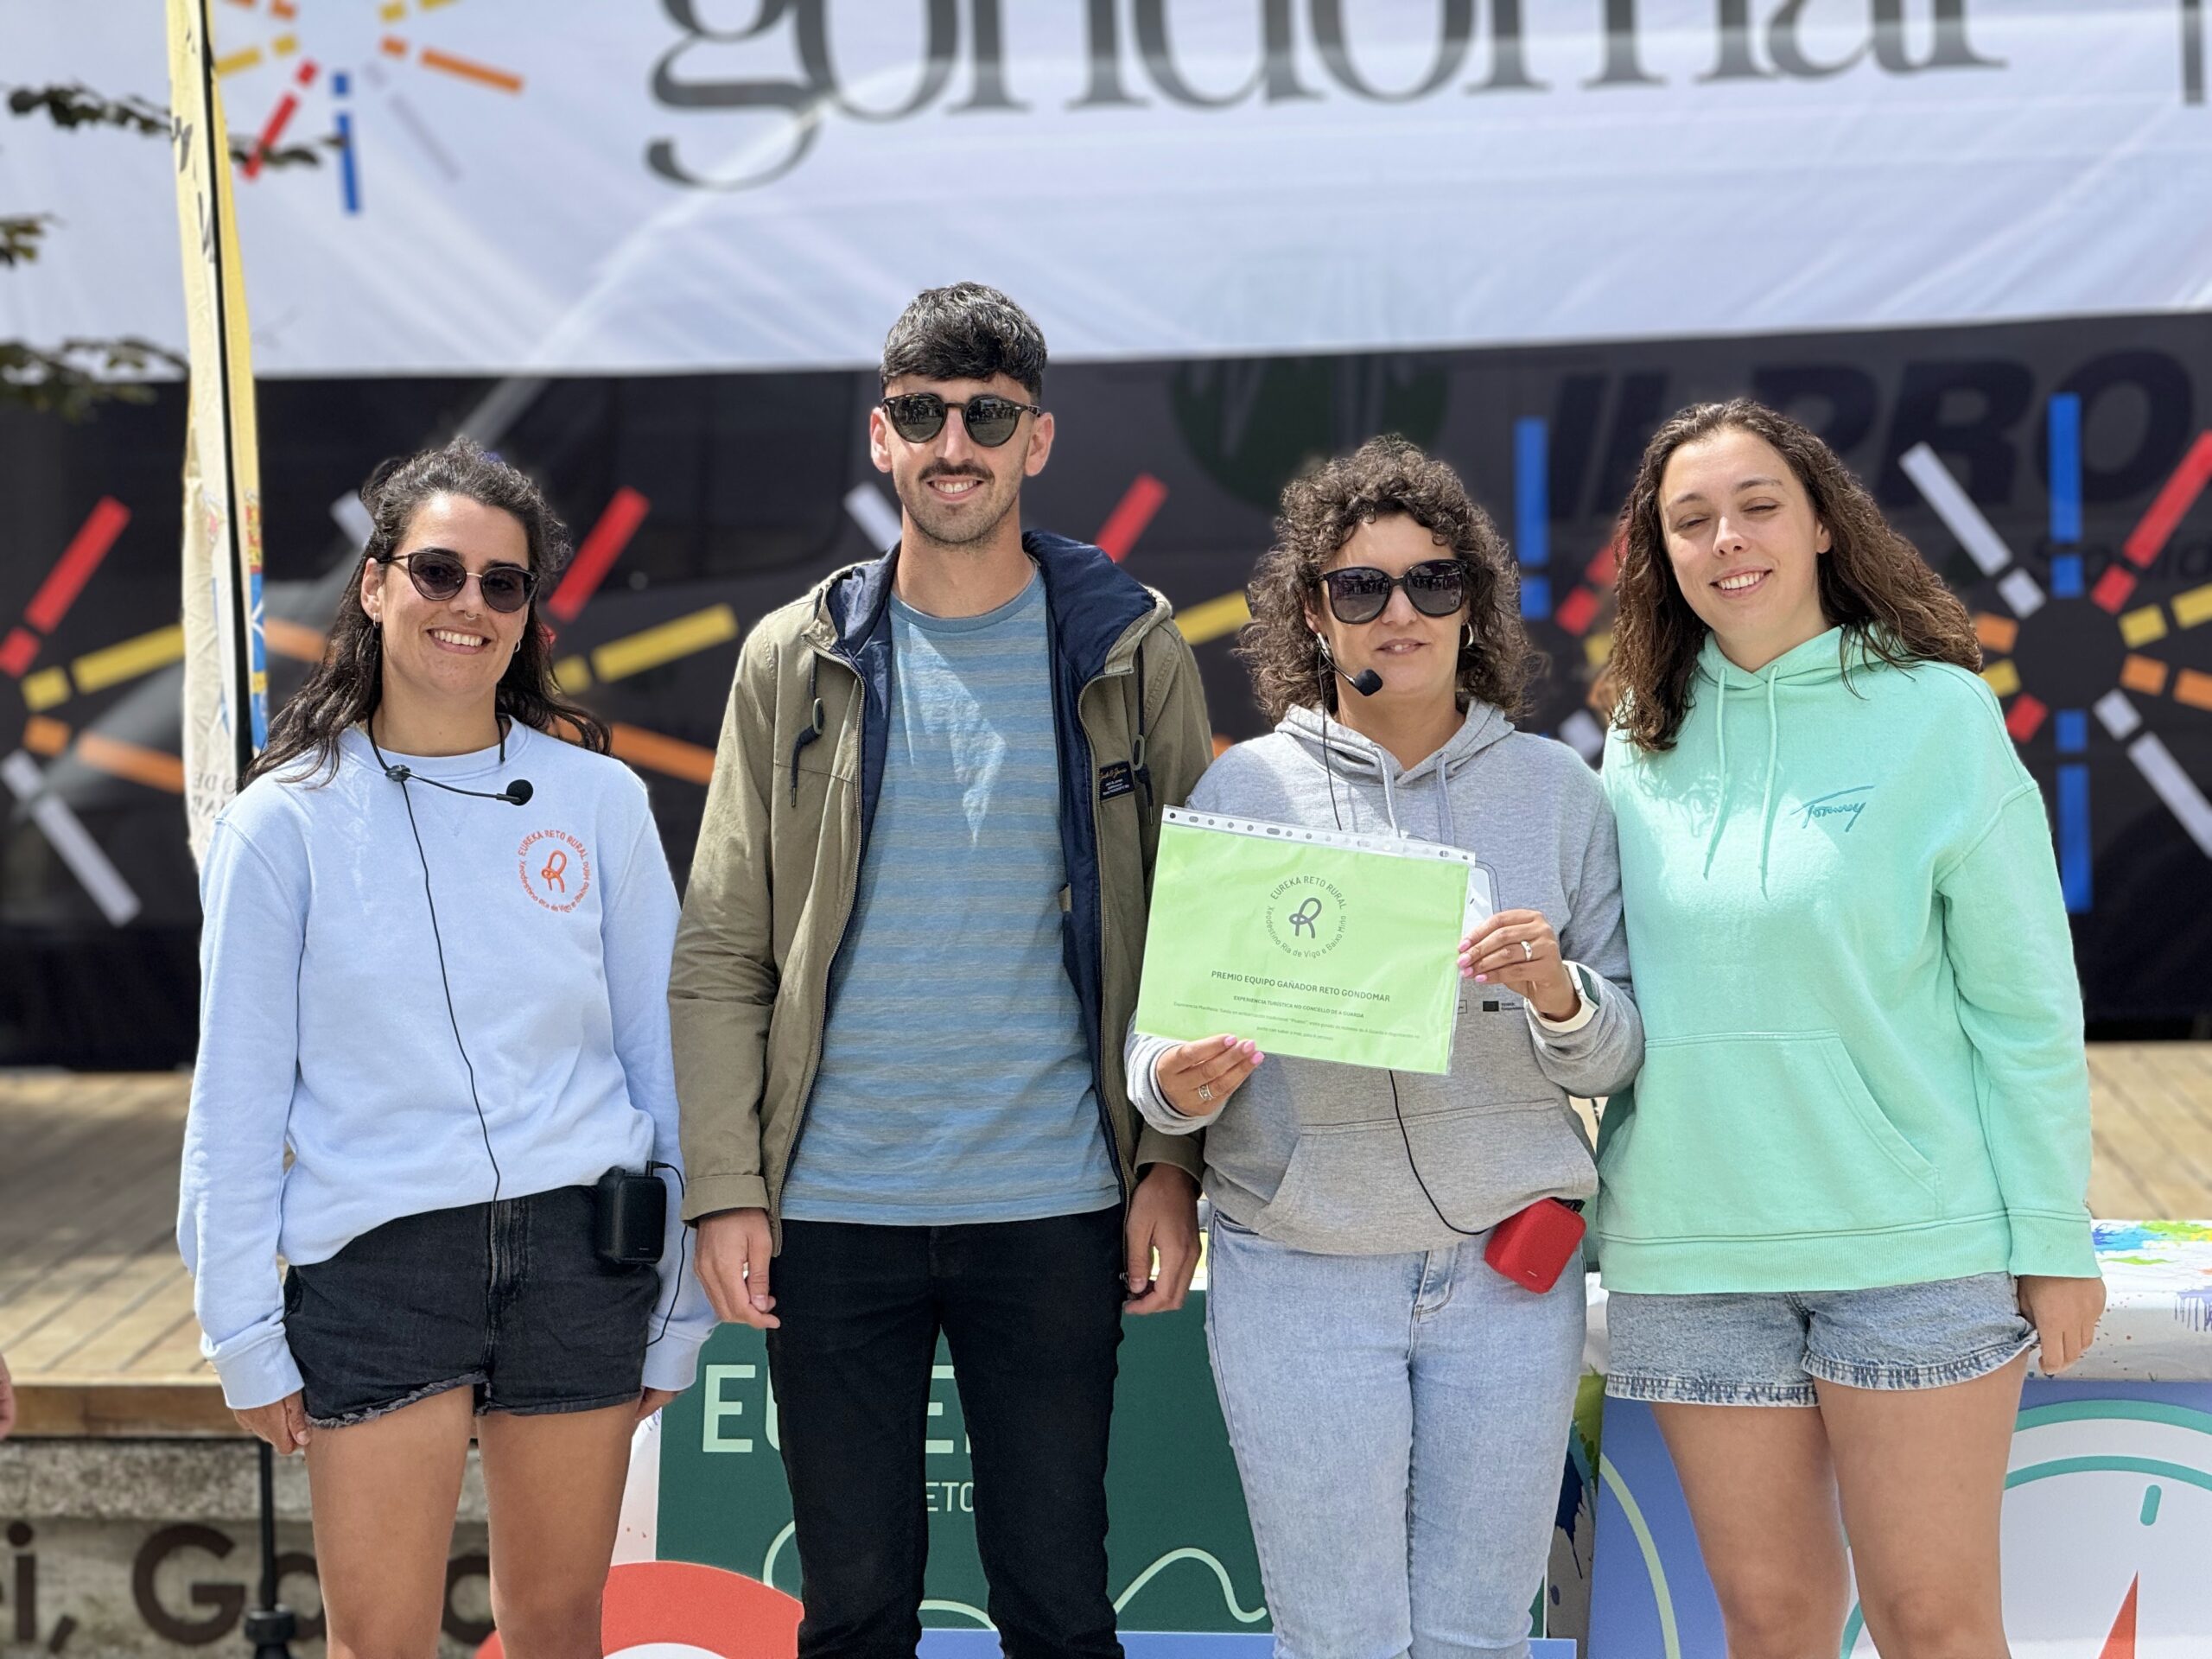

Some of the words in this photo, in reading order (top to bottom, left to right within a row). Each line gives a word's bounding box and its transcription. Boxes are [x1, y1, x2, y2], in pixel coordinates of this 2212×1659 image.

[1790, 785, 1874, 833] Tommy
[518, 831, 543, 856] EUREKA
[544, 830, 565, 841] RETO
[567, 836, 588, 861] RURAL
[1270, 877, 1301, 899] EUREKA
[1303, 875, 1325, 887] RETO
[1325, 883, 1347, 910] RURAL
[1304, 950, 1320, 959] Vigo
[1325, 933, 1343, 951] Baixo
[1211, 970, 1243, 982] PREMIO
[1244, 975, 1275, 987] EQUIPO
[1277, 979, 1317, 992] GAÑADOR
[1319, 986, 1340, 995] RETO
[1341, 989, 1390, 1002] GONDOMAR
[1234, 995, 1266, 1005] EXPERIENCIA
[1302, 1005, 1330, 1014] CONCELLO
[925, 1482, 975, 1512] ETO
